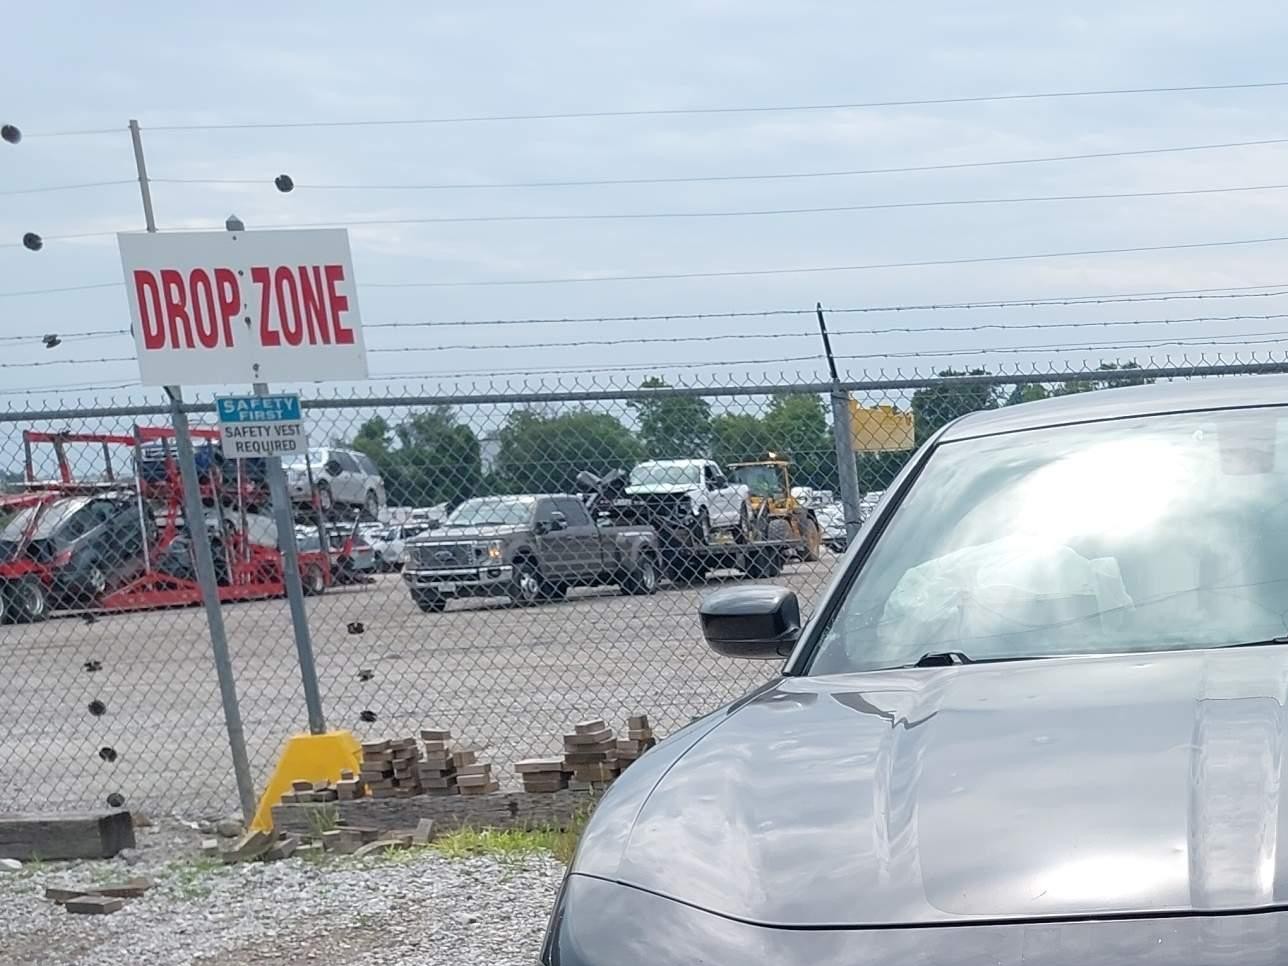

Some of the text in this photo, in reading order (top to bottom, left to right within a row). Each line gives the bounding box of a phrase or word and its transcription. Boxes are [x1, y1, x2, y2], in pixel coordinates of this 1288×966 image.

[133, 265, 355, 349] DROP ZONE
[222, 397, 294, 413] SAFETY
[239, 410, 283, 420] FIRST
[224, 424, 301, 438] SAFETY VEST
[235, 440, 297, 453] REQUIRED
